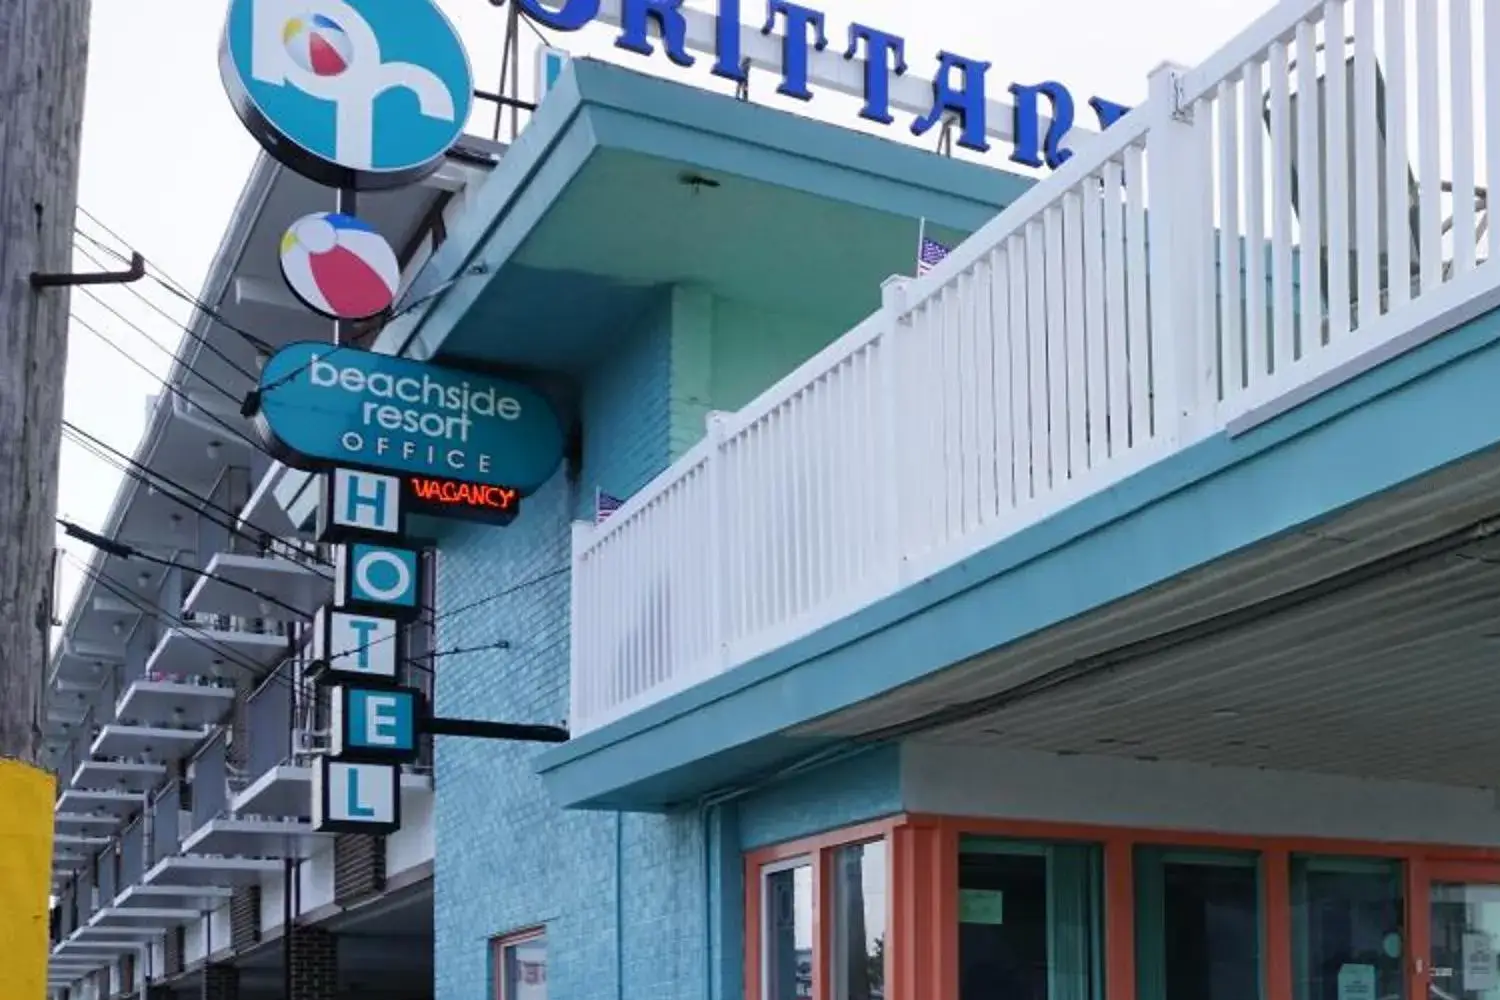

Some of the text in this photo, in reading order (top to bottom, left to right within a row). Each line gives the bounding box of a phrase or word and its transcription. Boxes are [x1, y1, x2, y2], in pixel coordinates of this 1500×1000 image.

[514, 0, 1133, 170] RITTAN
[310, 354, 522, 420] beachside
[363, 400, 472, 442] resort
[341, 431, 492, 474] OFFICE
[411, 477, 515, 508] VACANCY
[345, 474, 411, 817] HOTEL
